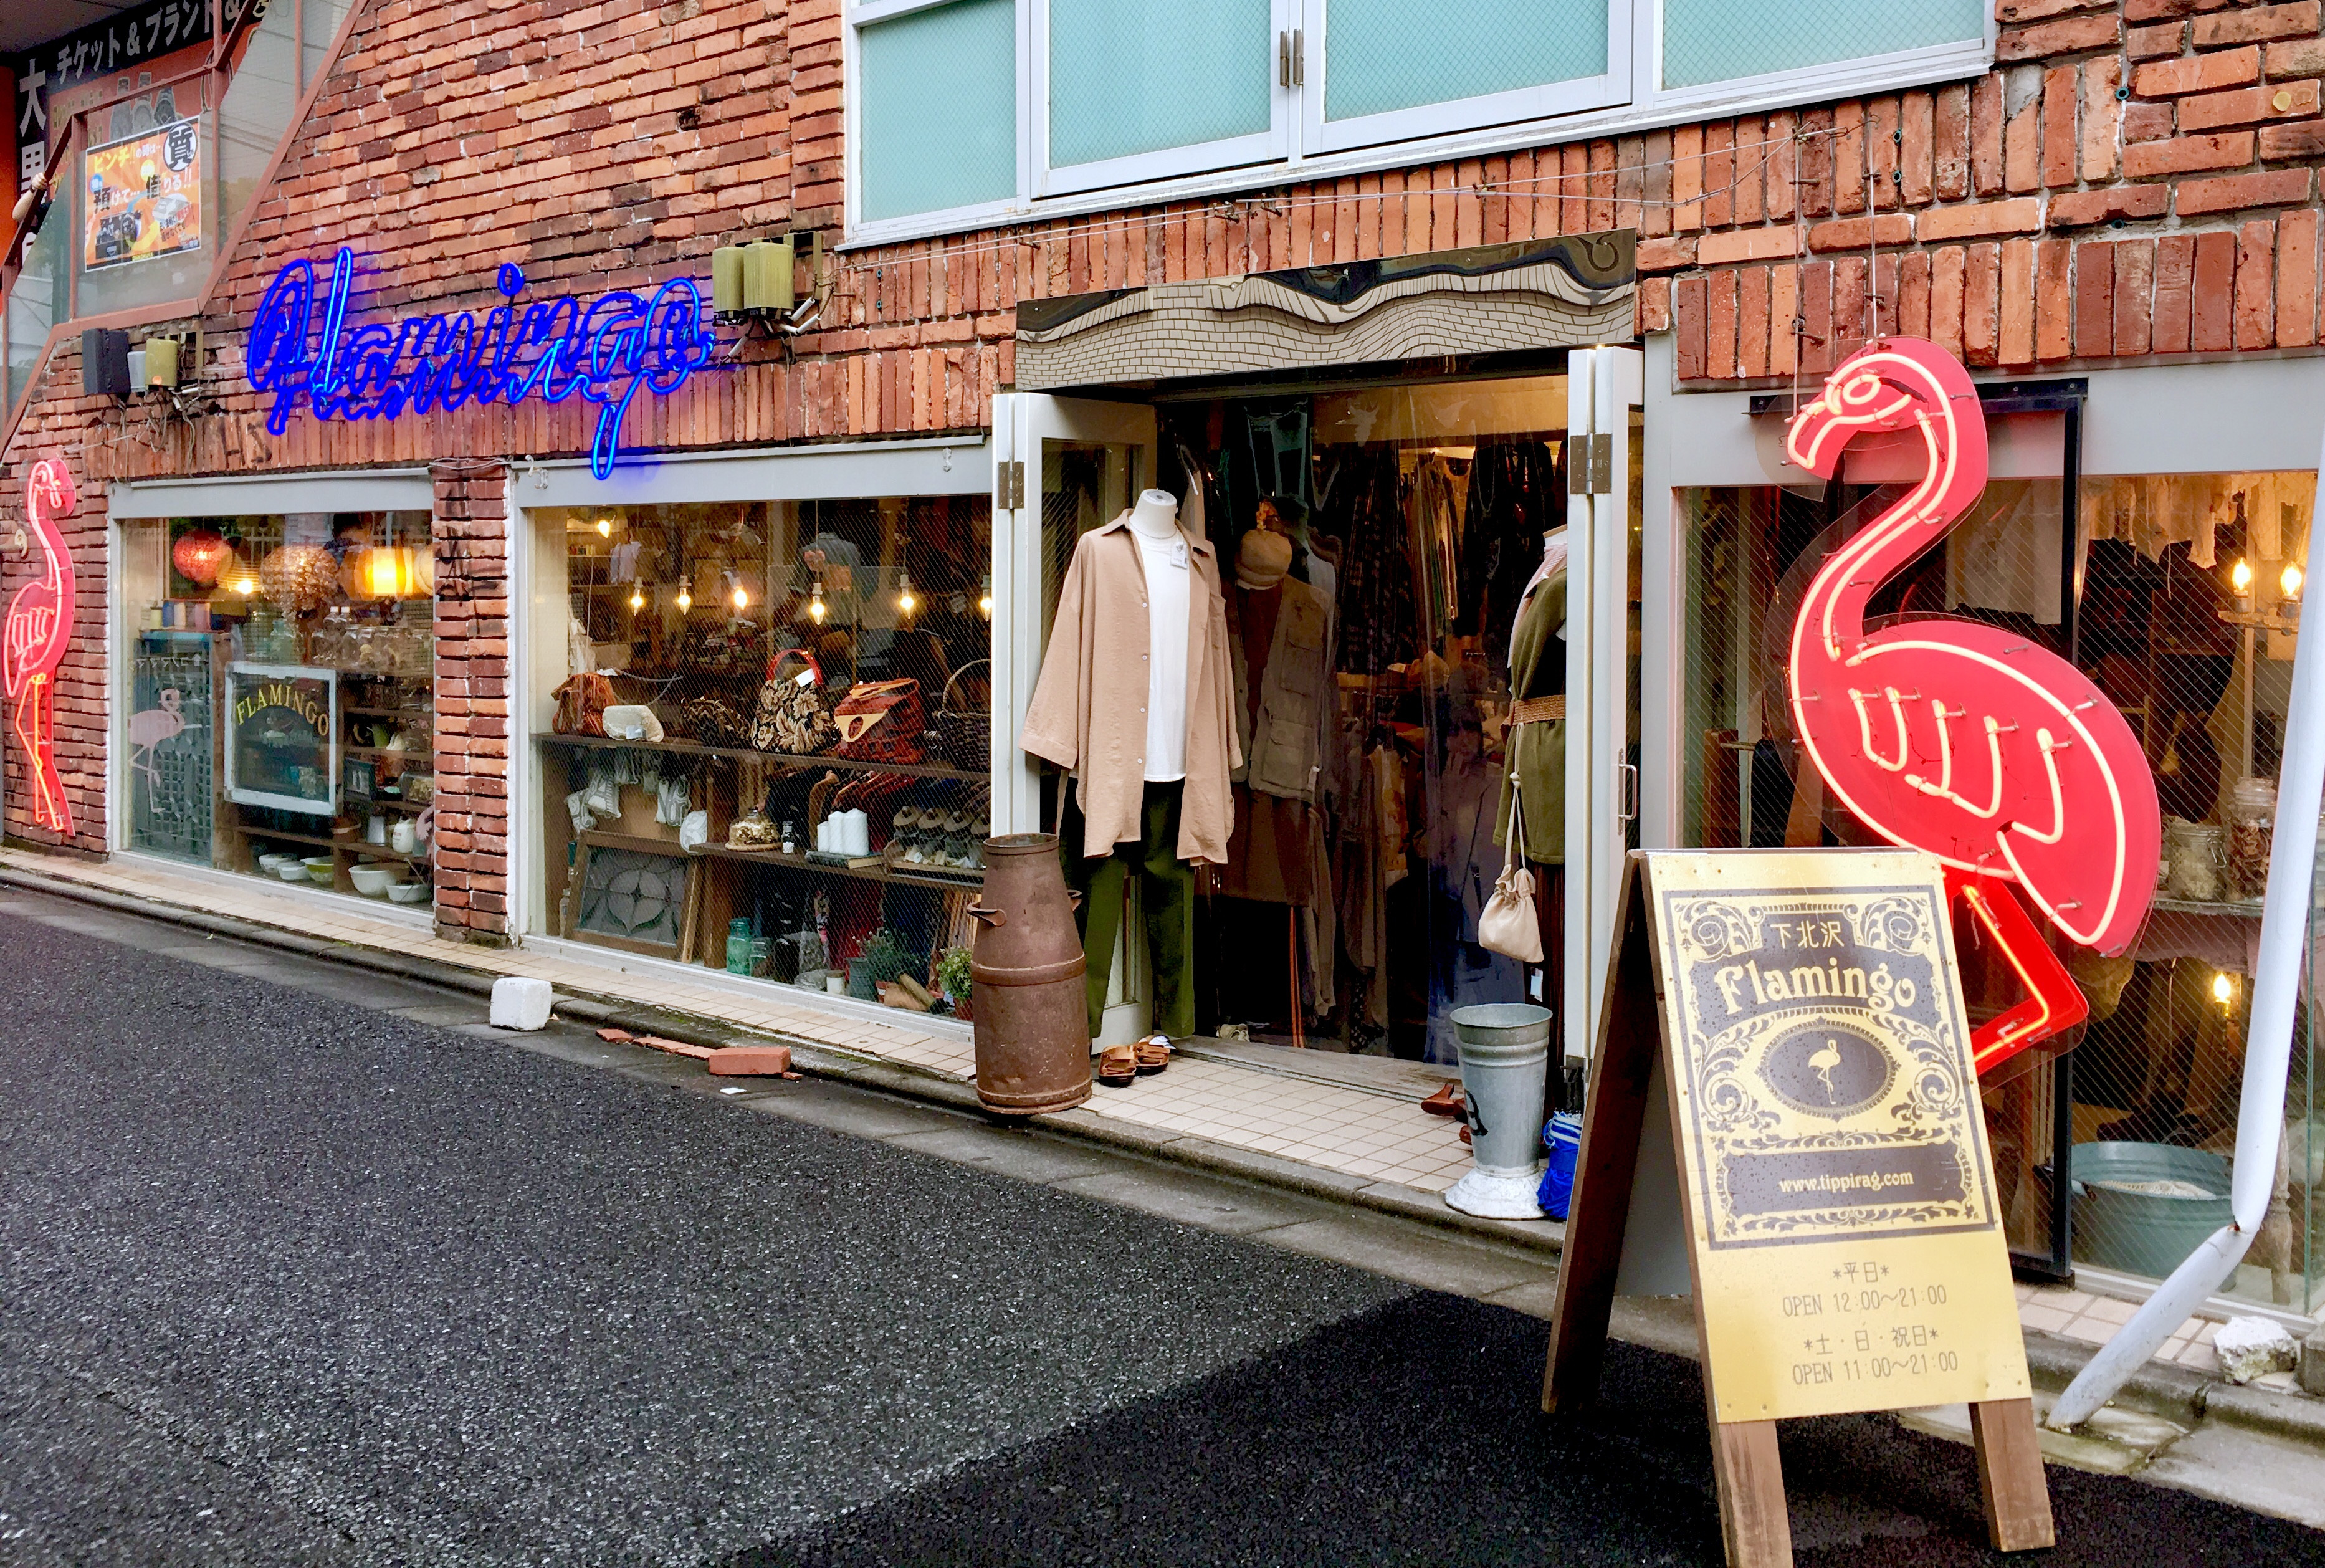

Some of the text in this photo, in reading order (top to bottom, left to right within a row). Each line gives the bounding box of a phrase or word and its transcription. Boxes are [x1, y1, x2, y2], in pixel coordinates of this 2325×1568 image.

[236, 683, 329, 736] FLAMINGO
[1770, 920, 1844, 949] 下北沢
[1714, 957, 1916, 1015] Flamingo
[1779, 1169, 1914, 1192] www.tippirag.com
[1782, 1294, 1823, 1317] OPEN
[1792, 1362, 1833, 1385] OPEN
